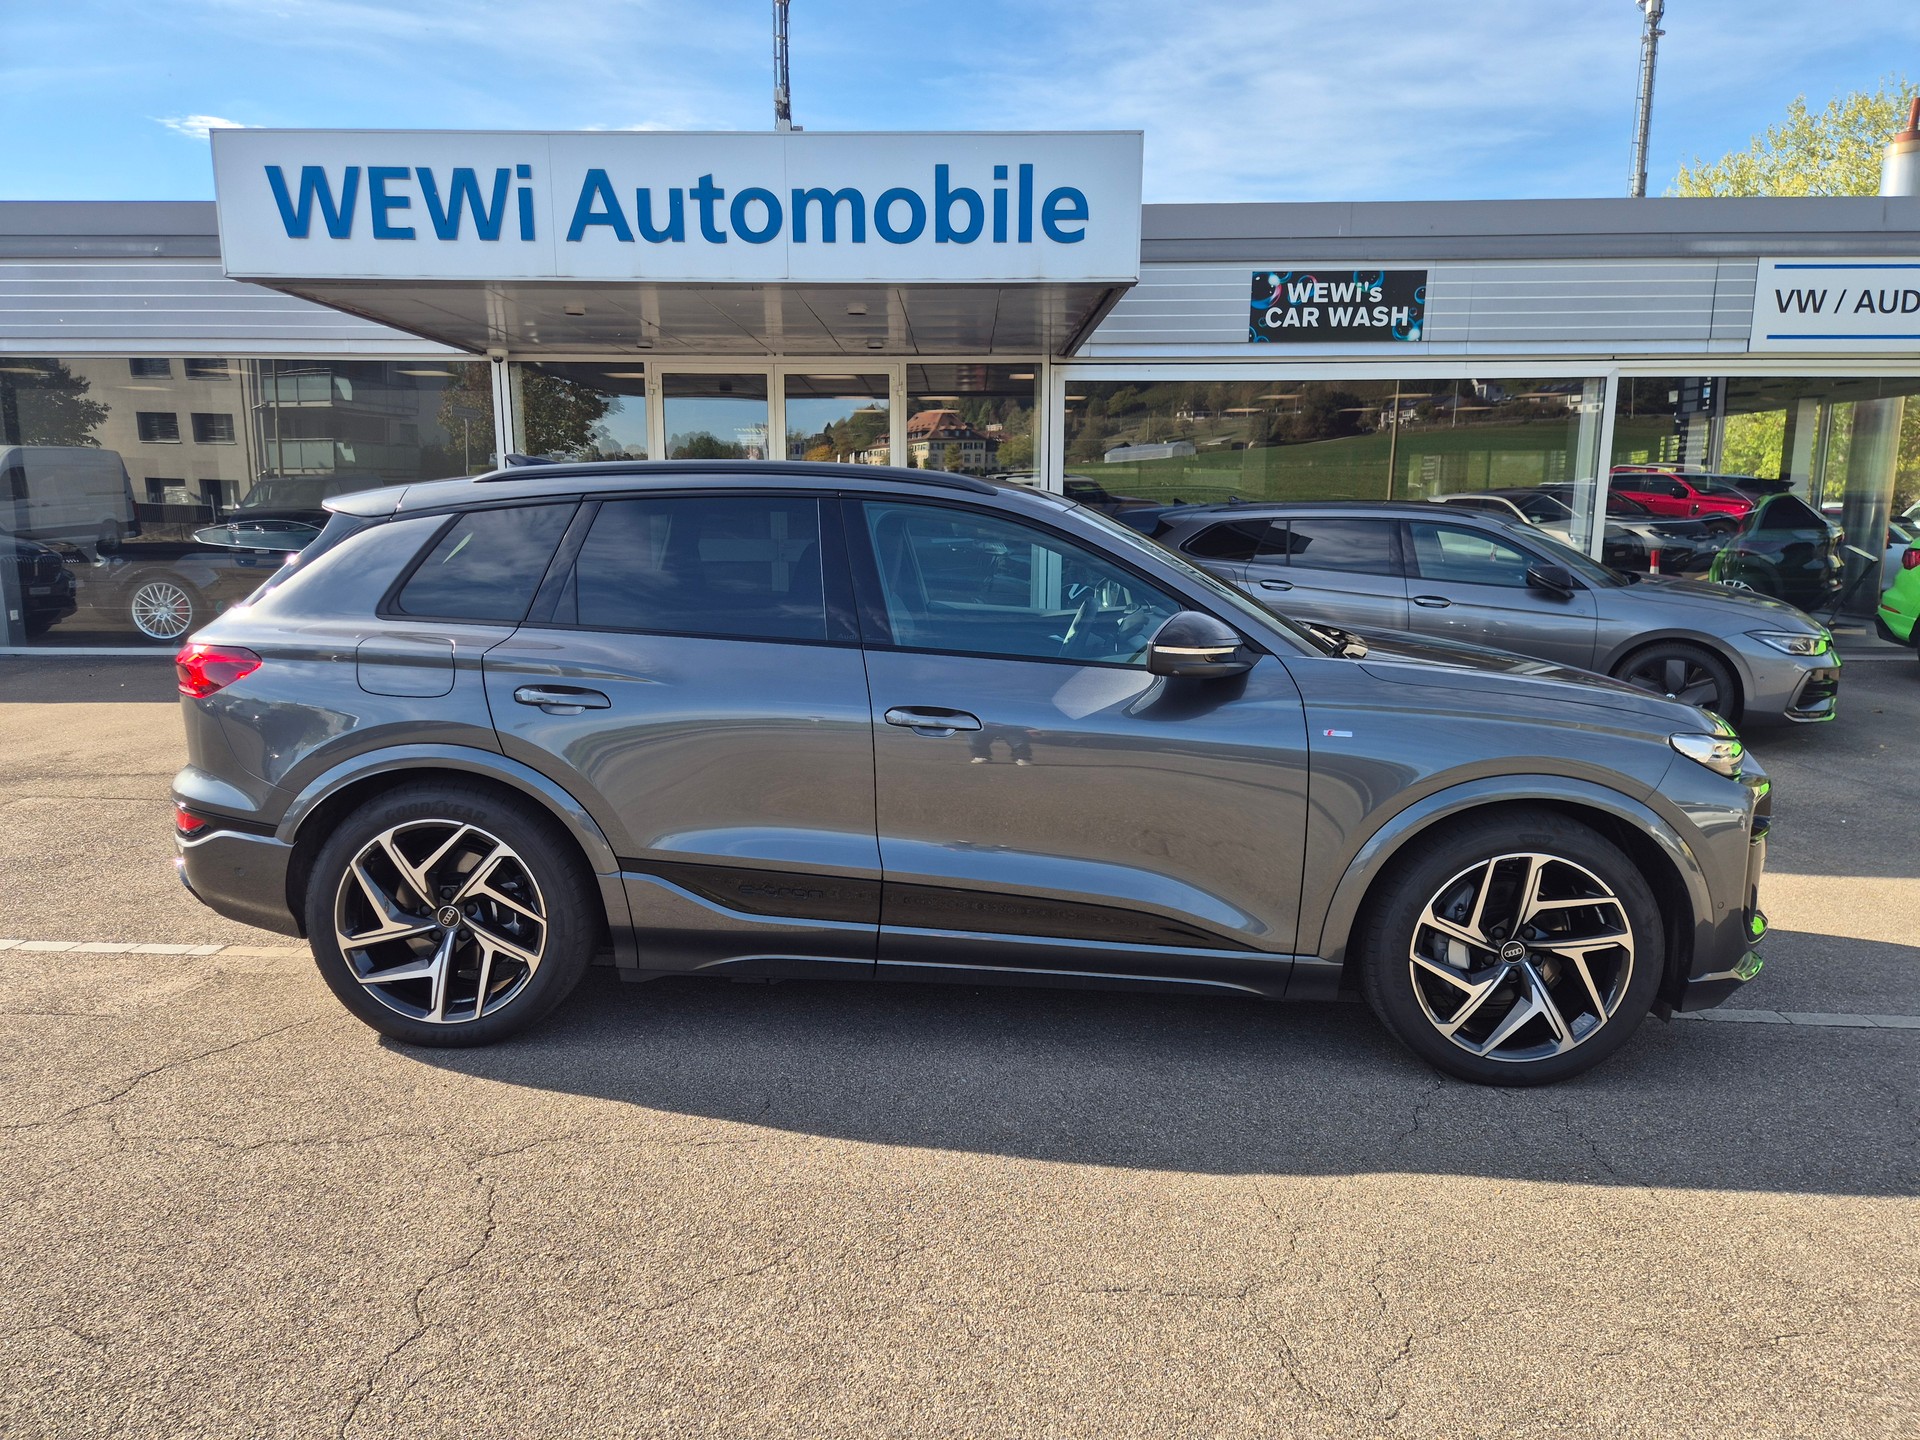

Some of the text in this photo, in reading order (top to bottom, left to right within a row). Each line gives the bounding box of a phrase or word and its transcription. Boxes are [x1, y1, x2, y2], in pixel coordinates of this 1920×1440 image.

[265, 164, 1089, 244] WEWi Automobile
[1287, 281, 1383, 303] WEWi's
[1775, 289, 1828, 313] VW
[1834, 289, 1848, 314] /
[1265, 306, 1409, 328] CAR WASH
